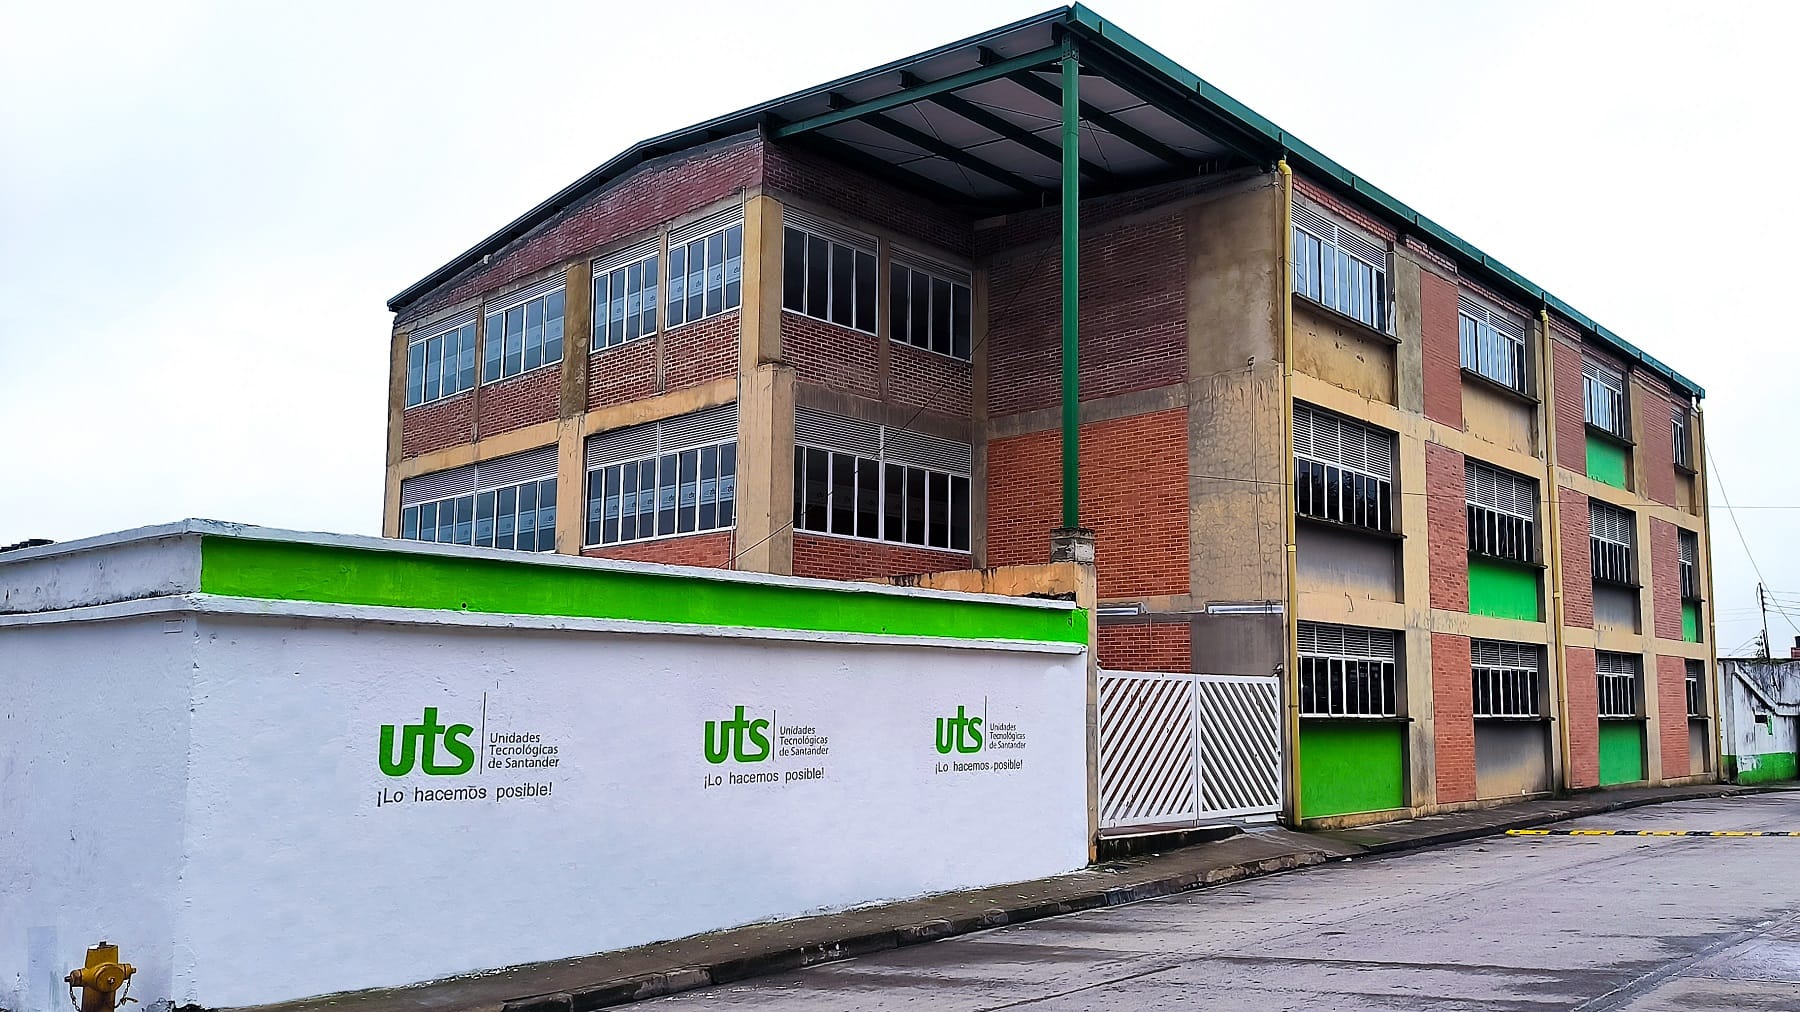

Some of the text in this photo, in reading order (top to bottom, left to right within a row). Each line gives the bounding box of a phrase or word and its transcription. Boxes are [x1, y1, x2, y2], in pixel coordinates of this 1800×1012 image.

[780, 726, 815, 735] Unidades
[936, 706, 983, 754] uts
[990, 723, 1016, 731] Unidades
[379, 706, 474, 776] uts
[490, 732, 540, 744] Unidades
[705, 706, 770, 764] uts
[780, 736, 828, 746] Tecnológicas
[990, 732, 1025, 741] Tecnológicas
[488, 743, 559, 757] Tecnológicas
[778, 745, 829, 756] de Santander
[989, 740, 1026, 749] de Santander
[487, 756, 560, 769] de Santander
[935, 759, 1023, 775] ¡Lo hacemos posible!
[704, 767, 824, 789] ¡Lo hacemos posible!
[377, 782, 552, 807] ¡Lo hacemos posible!
